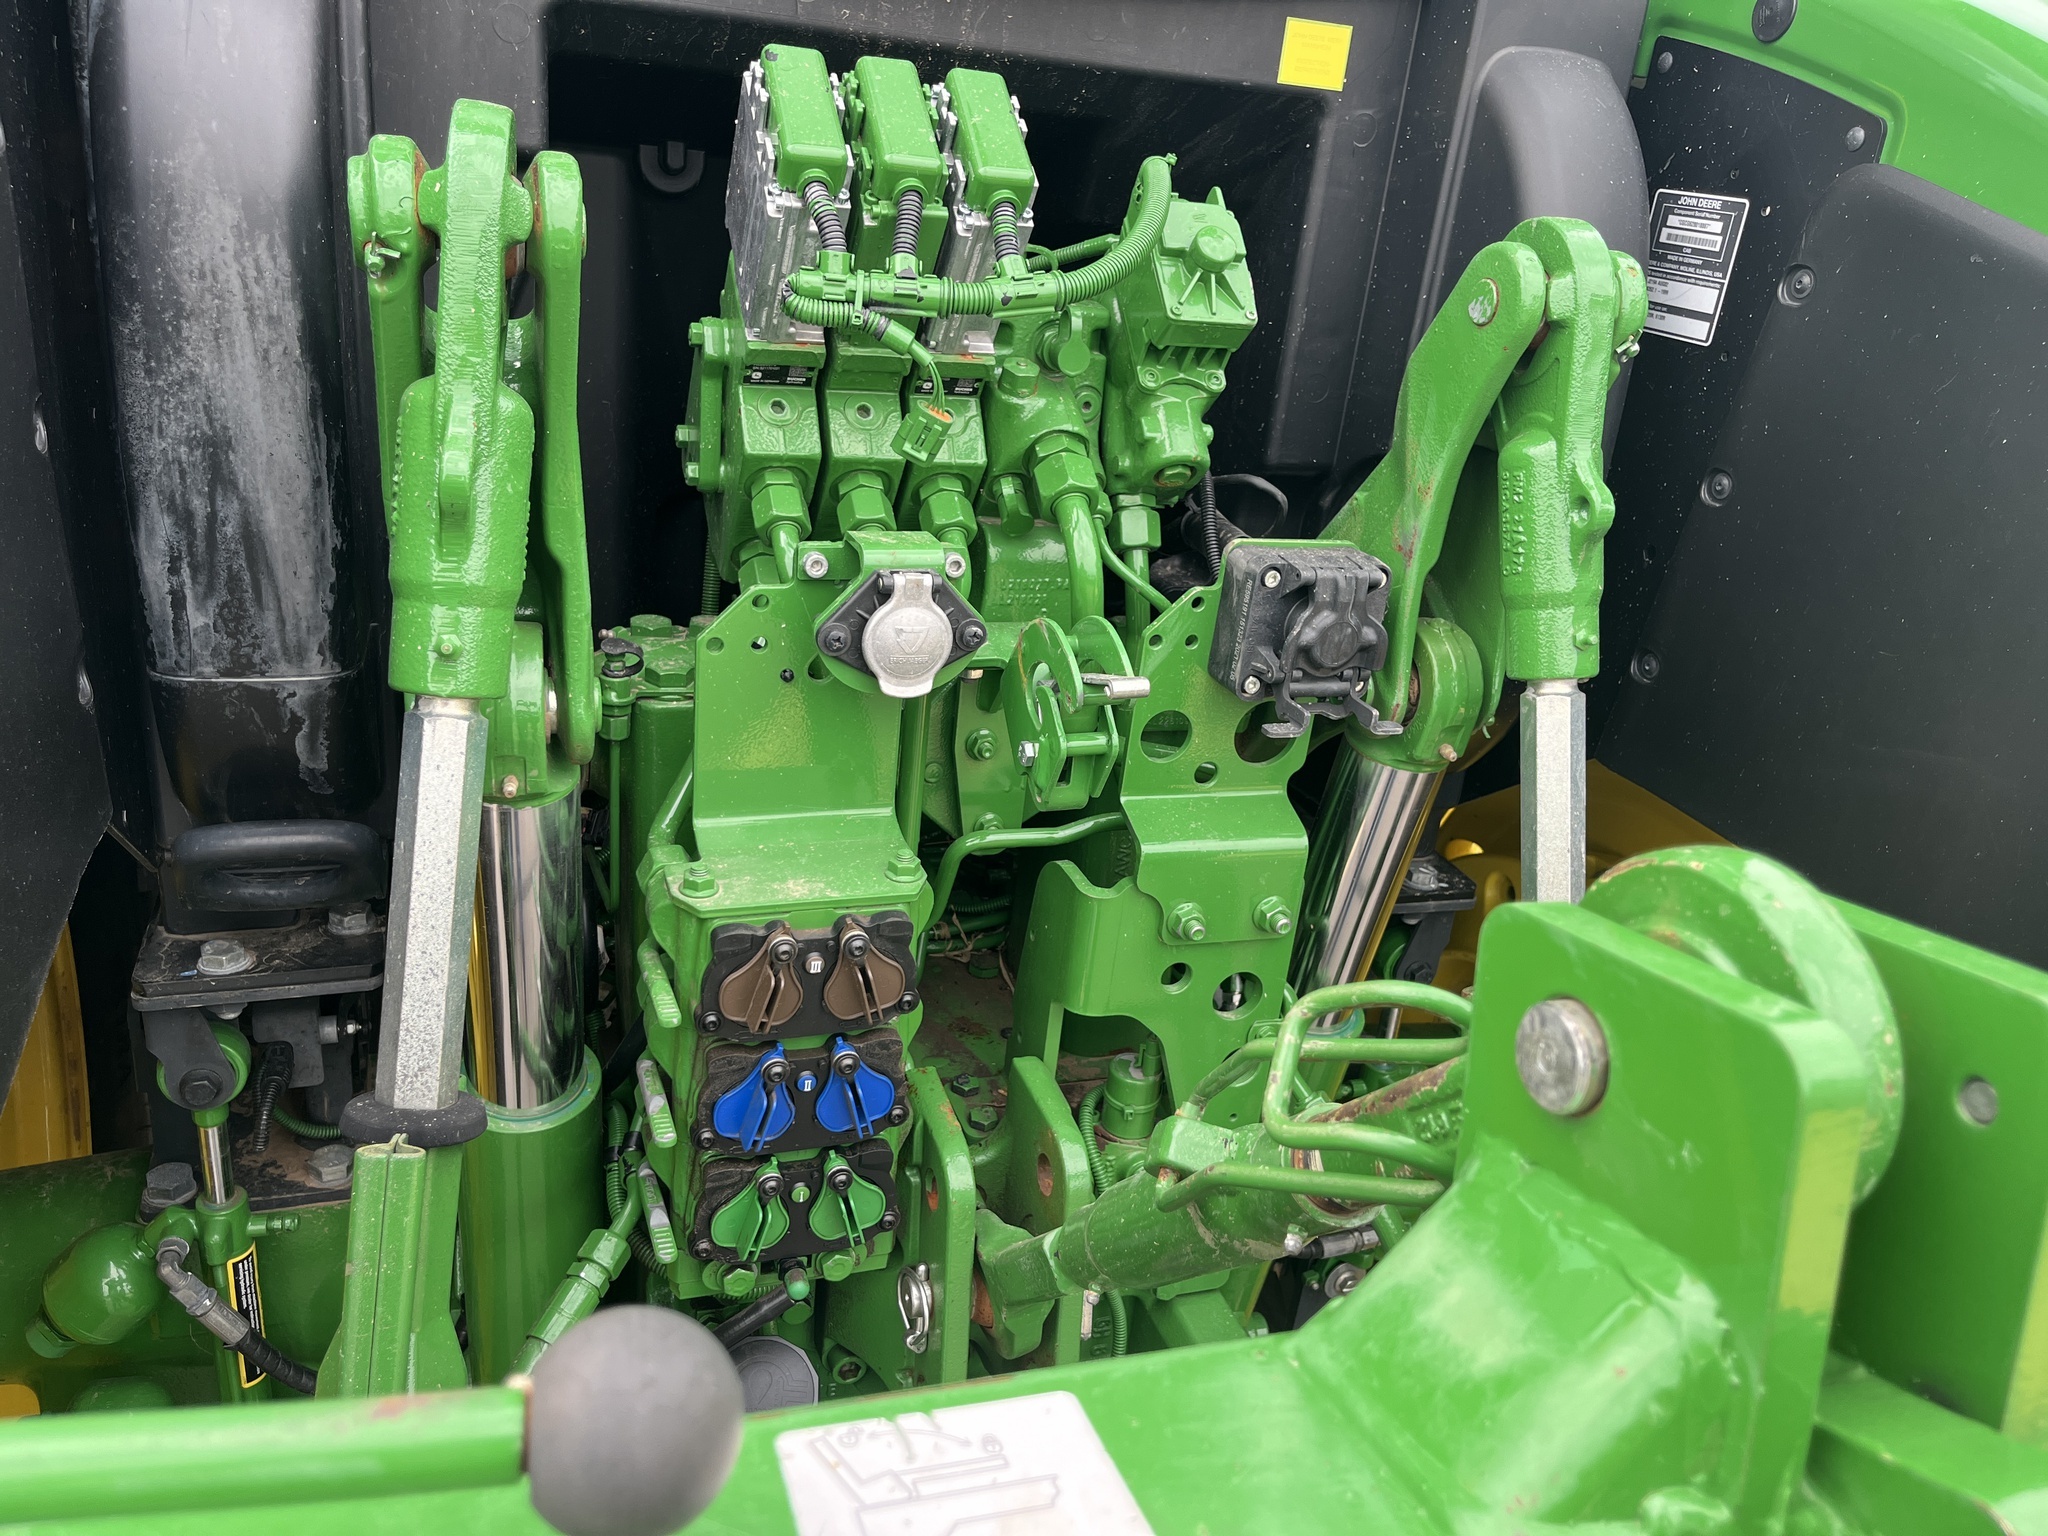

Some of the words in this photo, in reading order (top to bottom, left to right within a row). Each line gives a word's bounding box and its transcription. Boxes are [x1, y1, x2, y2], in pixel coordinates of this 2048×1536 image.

[1678, 196, 1698, 206] JOHN
[1698, 199, 1722, 209] DEERE
[1683, 257, 1703, 265] GERMANY
[810, 961, 823, 974] III
[803, 1080, 812, 1092] II
[799, 1191, 804, 1203] I
